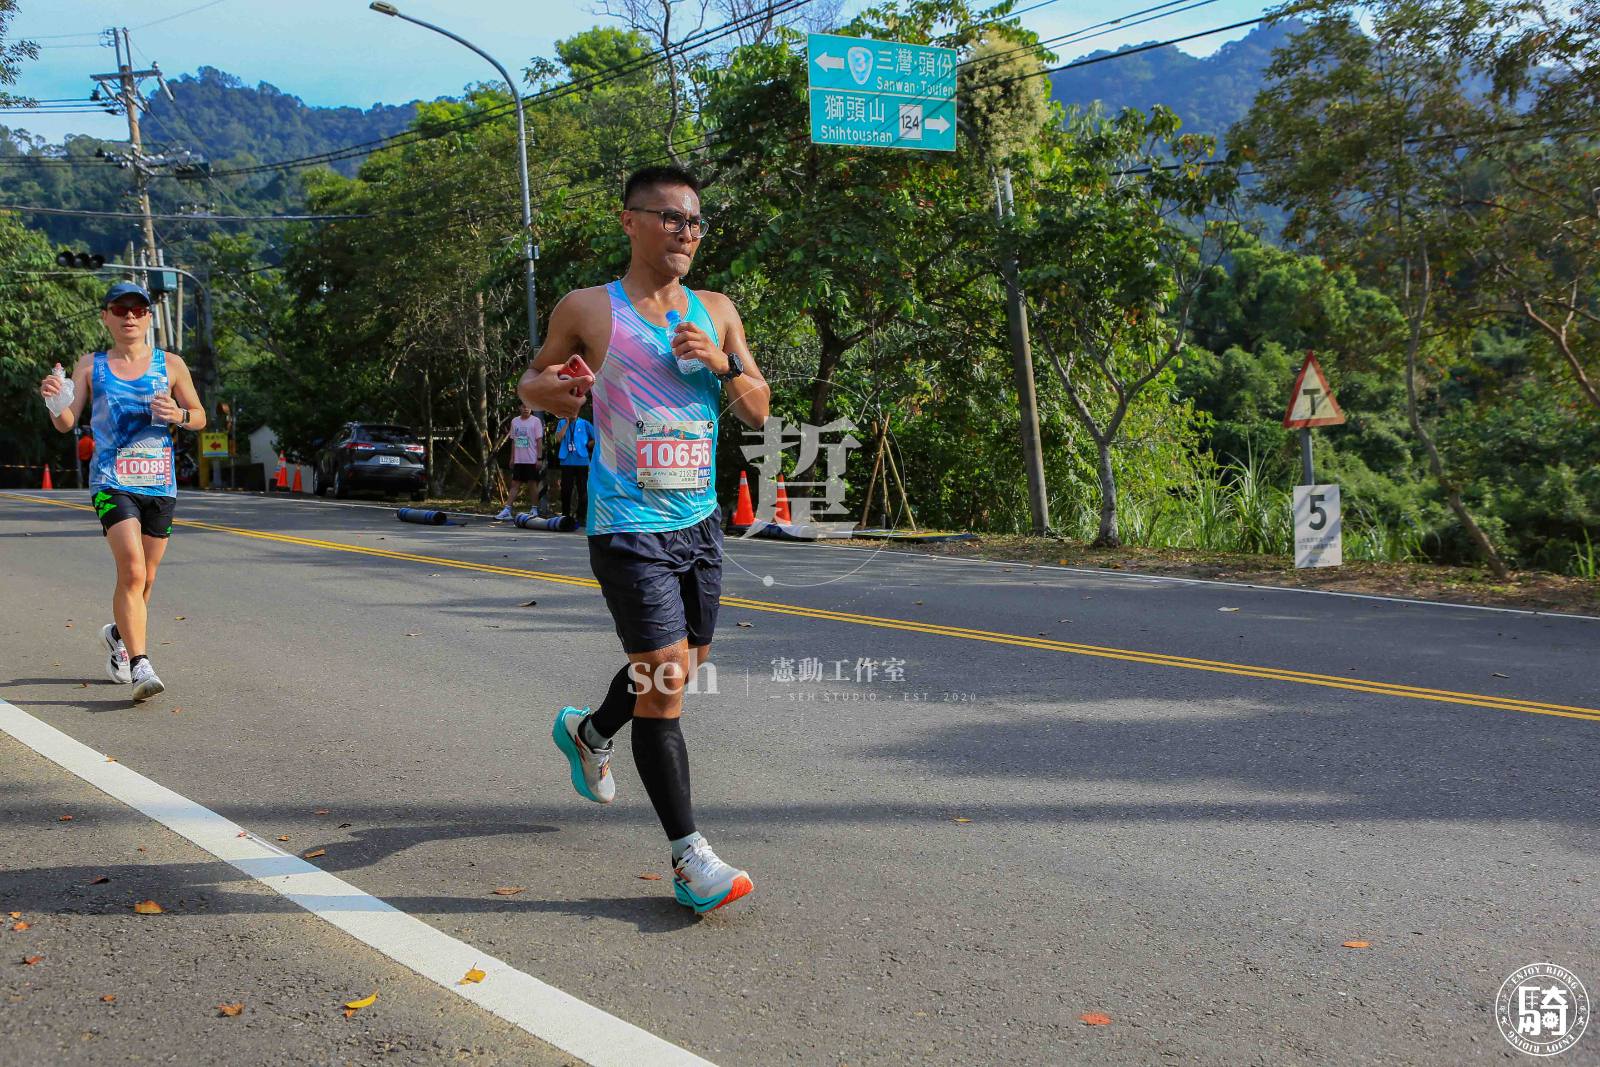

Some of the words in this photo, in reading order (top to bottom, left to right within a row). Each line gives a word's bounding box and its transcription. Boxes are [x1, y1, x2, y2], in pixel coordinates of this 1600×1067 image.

[854, 53, 866, 72] 3
[824, 94, 885, 124] 獅頭山
[901, 115, 920, 130] 124
[820, 124, 893, 143] Shihtoushan
[640, 442, 710, 467] 10656
[119, 460, 165, 474] 10089
[1308, 494, 1328, 531] 5
